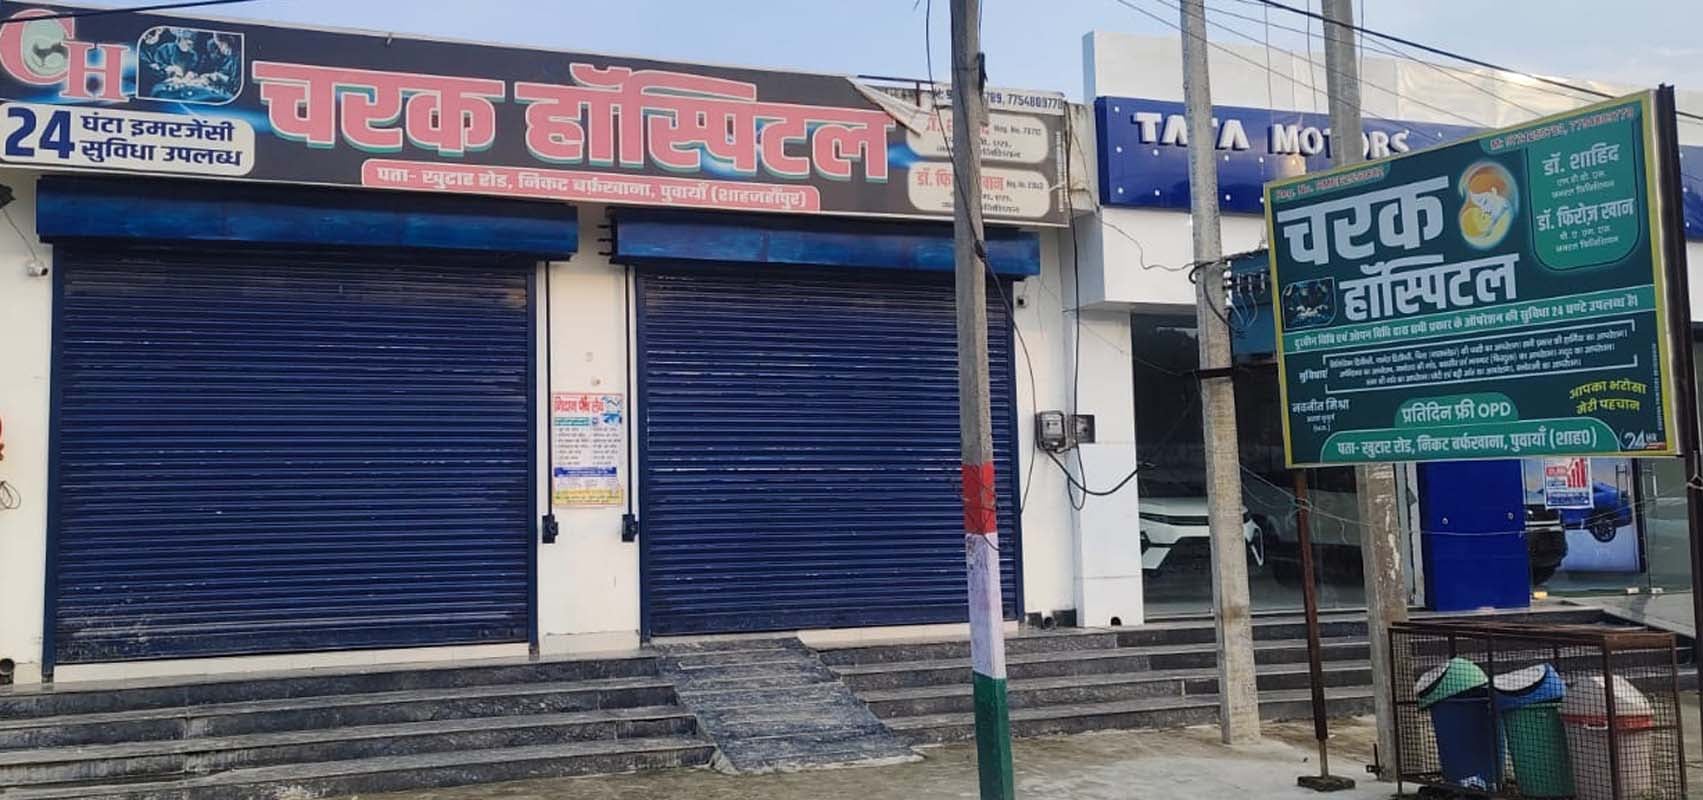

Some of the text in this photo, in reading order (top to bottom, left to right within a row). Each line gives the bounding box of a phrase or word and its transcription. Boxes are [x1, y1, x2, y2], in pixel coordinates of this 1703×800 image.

[5, 107, 75, 159] 24
[80, 113, 235, 142] घंटा इमरजेंसी
[252, 60, 895, 182] चरक हॉस्पिटल
[1134, 112, 1409, 160] TAA MORS
[80, 138, 243, 166] सुविधा उपलब्ध
[1542, 142, 1620, 175] डॉ. शाहिद
[422, 170, 474, 189] खुटार
[479, 170, 512, 189] रोड,
[518, 172, 567, 191] निकट
[916, 168, 933, 186] डॉ.
[1277, 176, 1449, 266] चरक
[1537, 208, 1554, 231] डॉ.
[1601, 198, 1634, 220] खान
[1338, 253, 1520, 321] हॉस्पिटल
[1521, 306, 1549, 325] सुविधा
[1552, 305, 1563, 317] 24
[1569, 381, 1607, 400] आपका
[1402, 399, 1511, 424] प्रतिदिन फ्री OPD
[1598, 398, 1640, 412] पहचान
[1362, 440, 1391, 458] खुटार
[1394, 436, 1415, 456] रोड,
[1417, 434, 1449, 452] निकट
